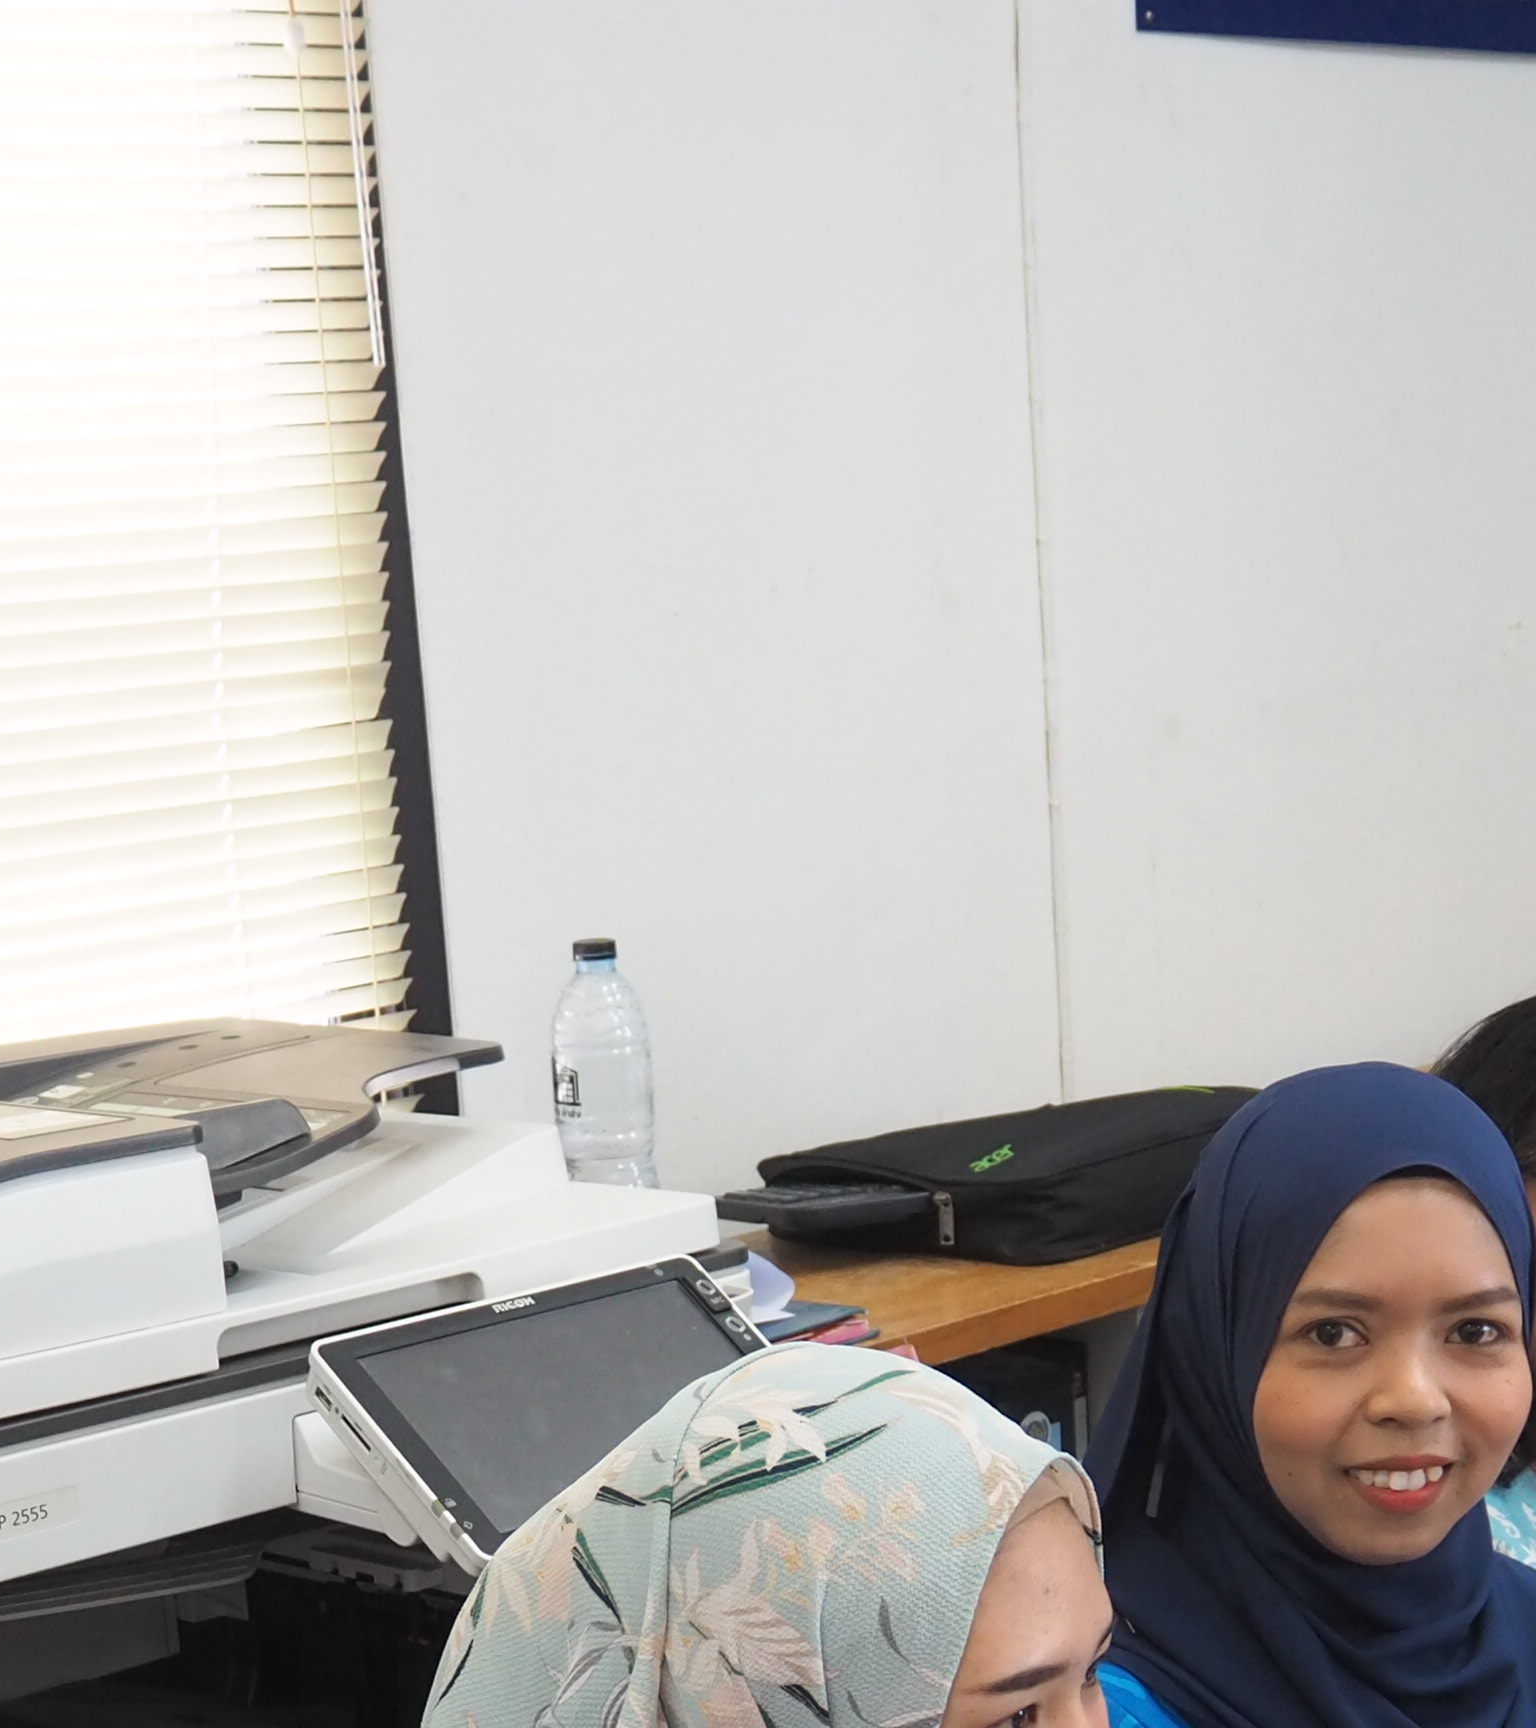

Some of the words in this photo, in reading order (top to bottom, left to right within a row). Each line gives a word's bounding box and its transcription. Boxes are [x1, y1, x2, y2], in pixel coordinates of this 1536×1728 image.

[969, 1143, 1015, 1172] acer
[491, 1296, 536, 1314] RICOH
[11, 1503, 48, 1527] 2555
